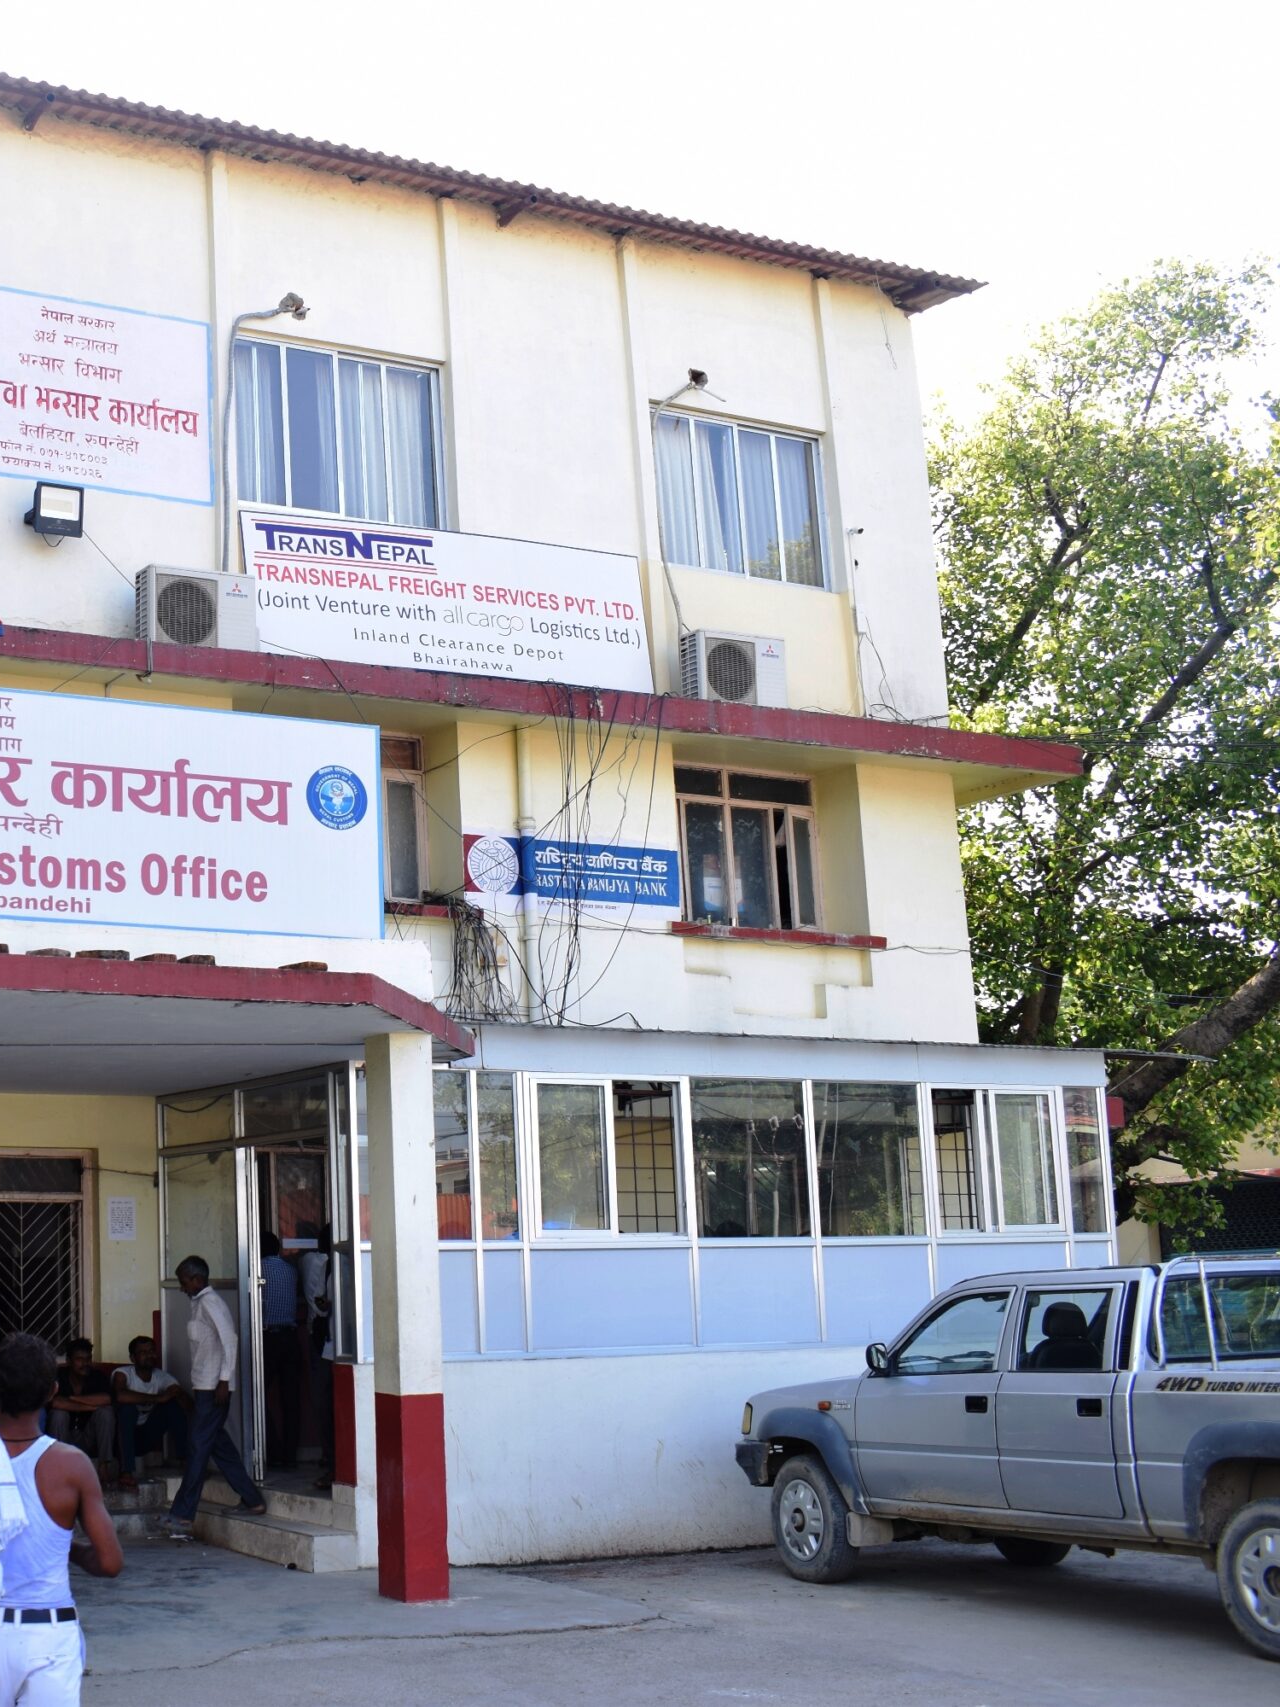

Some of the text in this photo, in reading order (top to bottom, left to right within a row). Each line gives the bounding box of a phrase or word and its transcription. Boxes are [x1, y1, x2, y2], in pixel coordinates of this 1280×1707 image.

[40, 306, 115, 332] नेपाल सरकार
[33, 328, 56, 344] अर्थ
[19, 352, 122, 384] भन्सार विभाग
[34, 386, 101, 421] भन्सार
[108, 396, 199, 438] कार्यालय
[0, 438, 22, 452] फोन
[253, 563, 639, 621] TRANSNEPAL FREIGHT SERVICES PVT. LTD.
[257, 588, 310, 612] (Joint
[315, 596, 390, 619] Venture
[396, 604, 437, 623] with
[530, 617, 600, 642] Logistics
[604, 626, 642, 649] Ltd.)
[353, 627, 564, 661] Inland Clearance Depot
[413, 652, 514, 673] Bhairahawa
[51, 758, 292, 825] कार्यालय
[141, 853, 268, 902] Office
[635, 882, 667, 897] BANK
[1156, 1377, 1280, 1393] 4WD TURBO INTER
